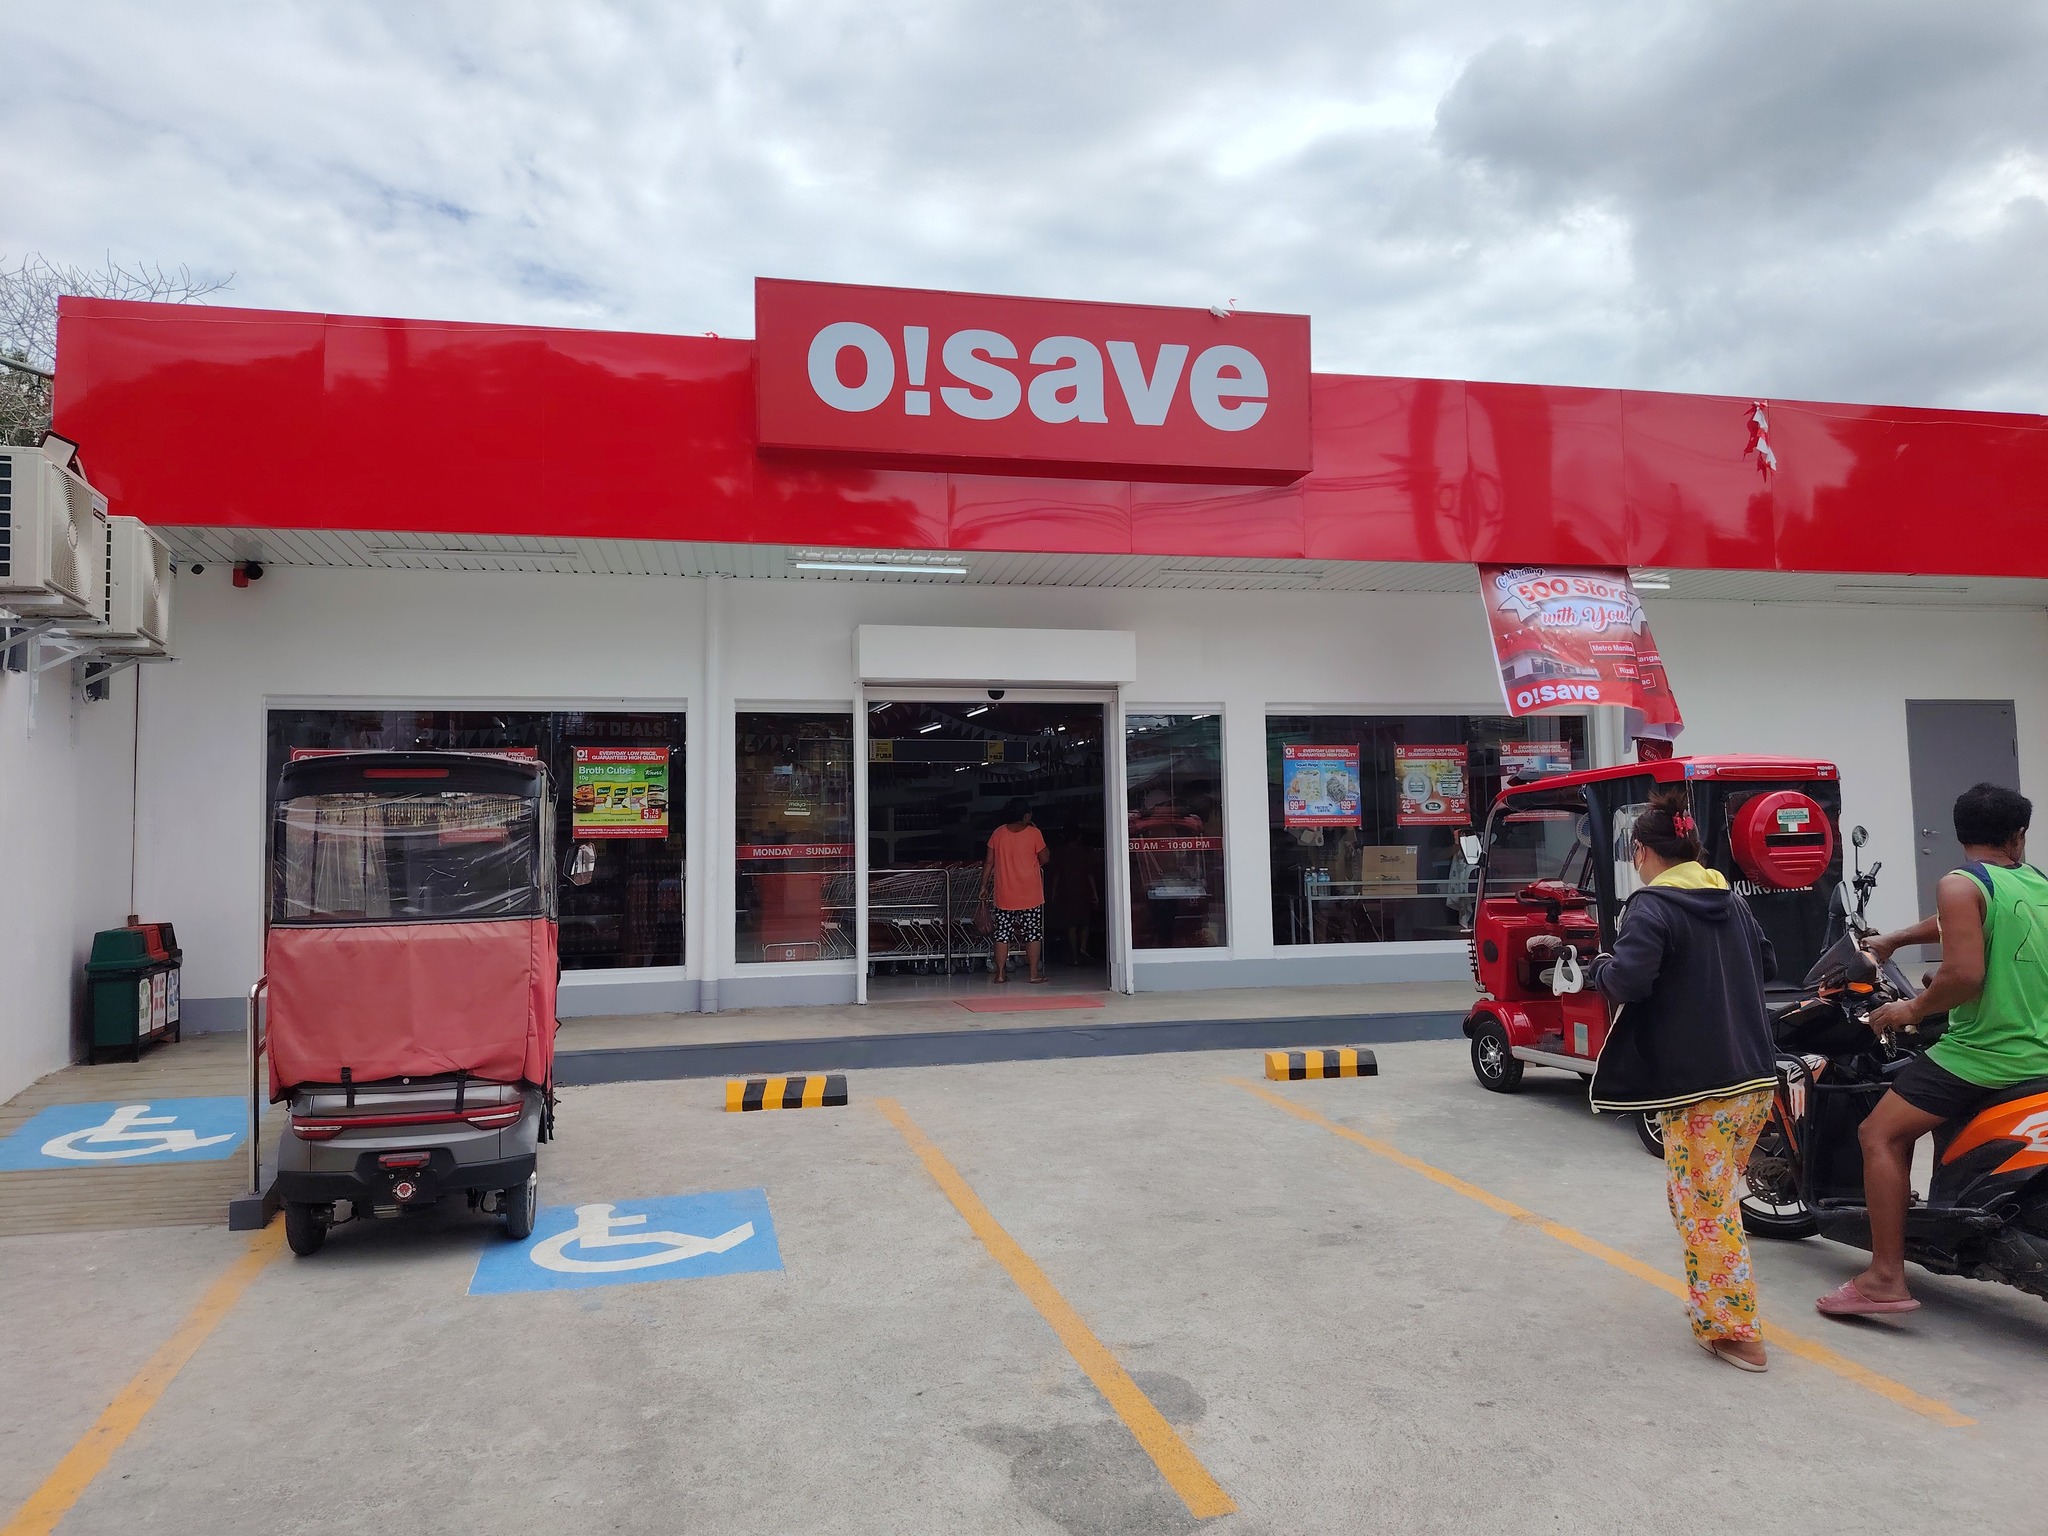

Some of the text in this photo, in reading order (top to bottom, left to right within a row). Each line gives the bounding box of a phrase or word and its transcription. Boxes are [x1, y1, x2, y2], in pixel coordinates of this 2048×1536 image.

[807, 321, 1269, 432] o!save
[1517, 578, 1569, 601] 500
[1542, 607, 1576, 624] with
[1592, 644, 1634, 652] Metro Manila
[1516, 685, 1600, 708] o!save
[579, 766, 636, 774] Broth Cubes
[752, 846, 843, 856] MONDAY SUNDAY
